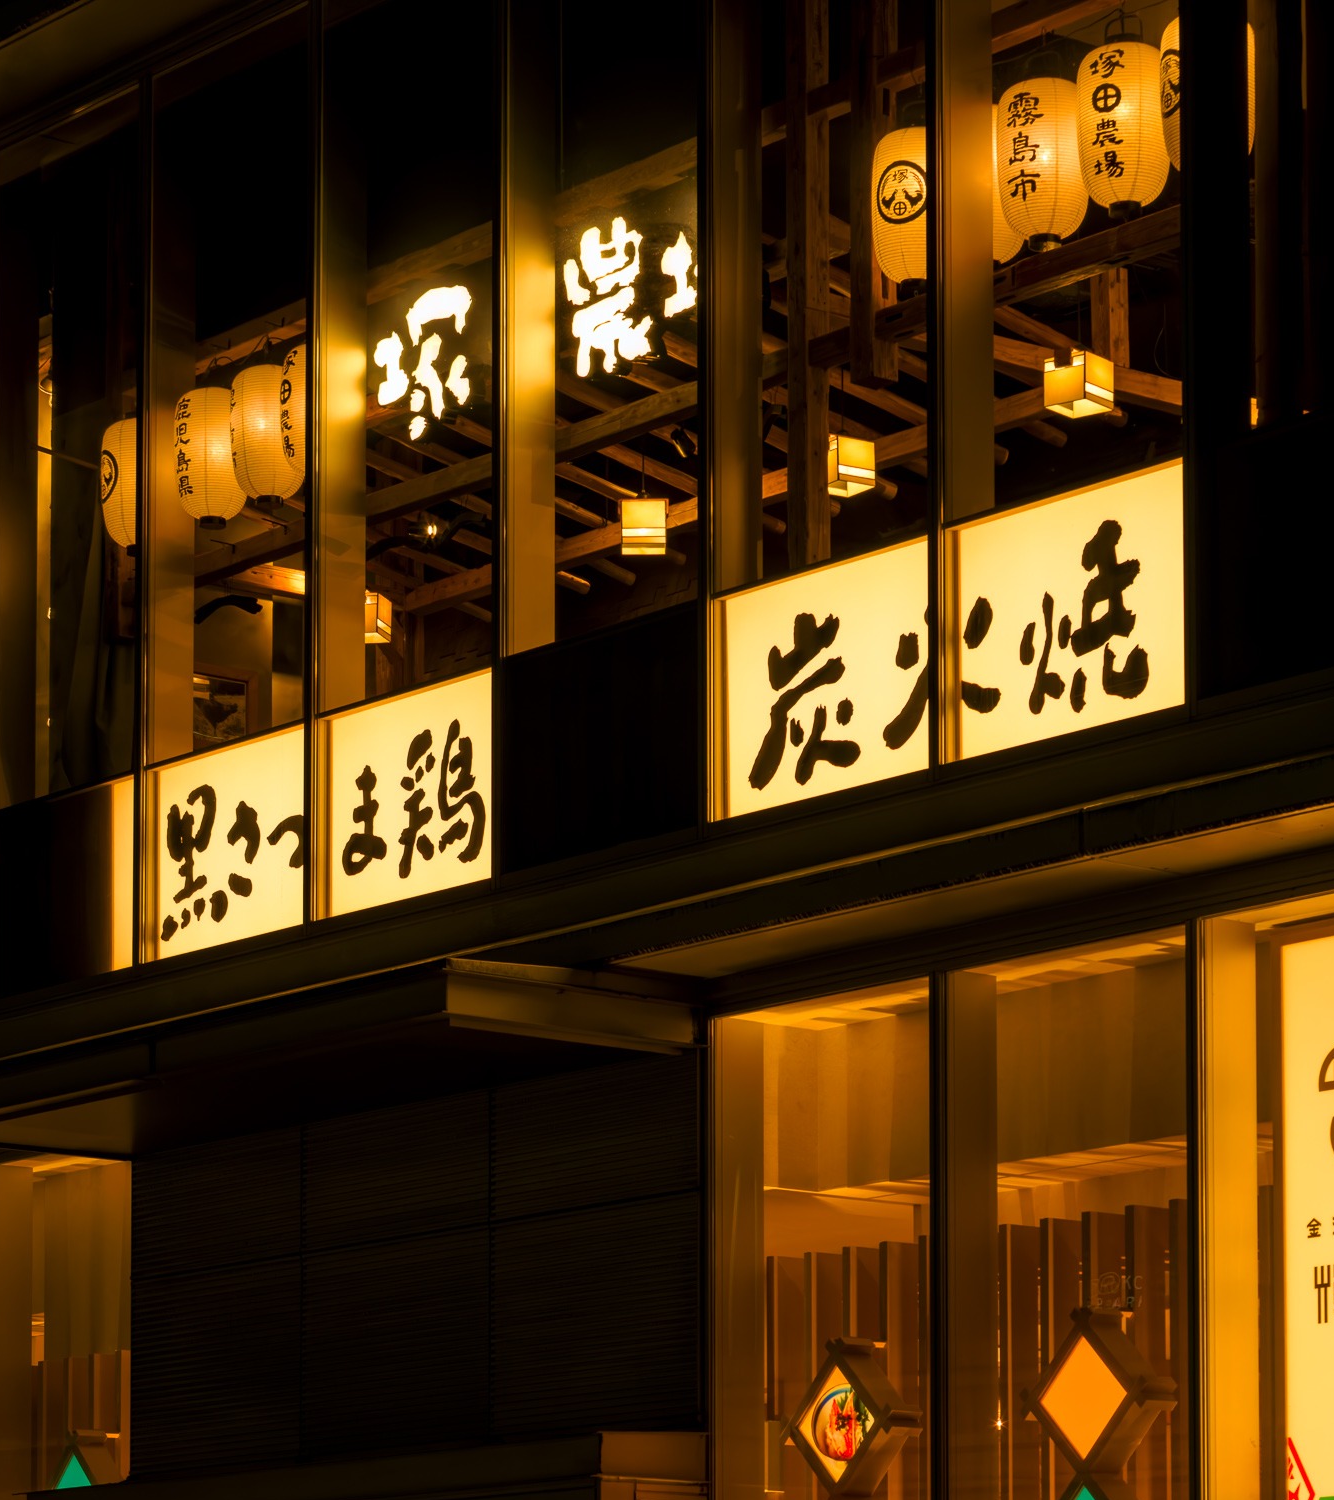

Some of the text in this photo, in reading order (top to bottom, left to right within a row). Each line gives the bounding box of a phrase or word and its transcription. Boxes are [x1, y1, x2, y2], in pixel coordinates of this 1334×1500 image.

[1007, 92, 1044, 201] 霧島市
[749, 519, 1150, 791] 炭火焼
[160, 718, 486, 942] 黒さつま鶏
